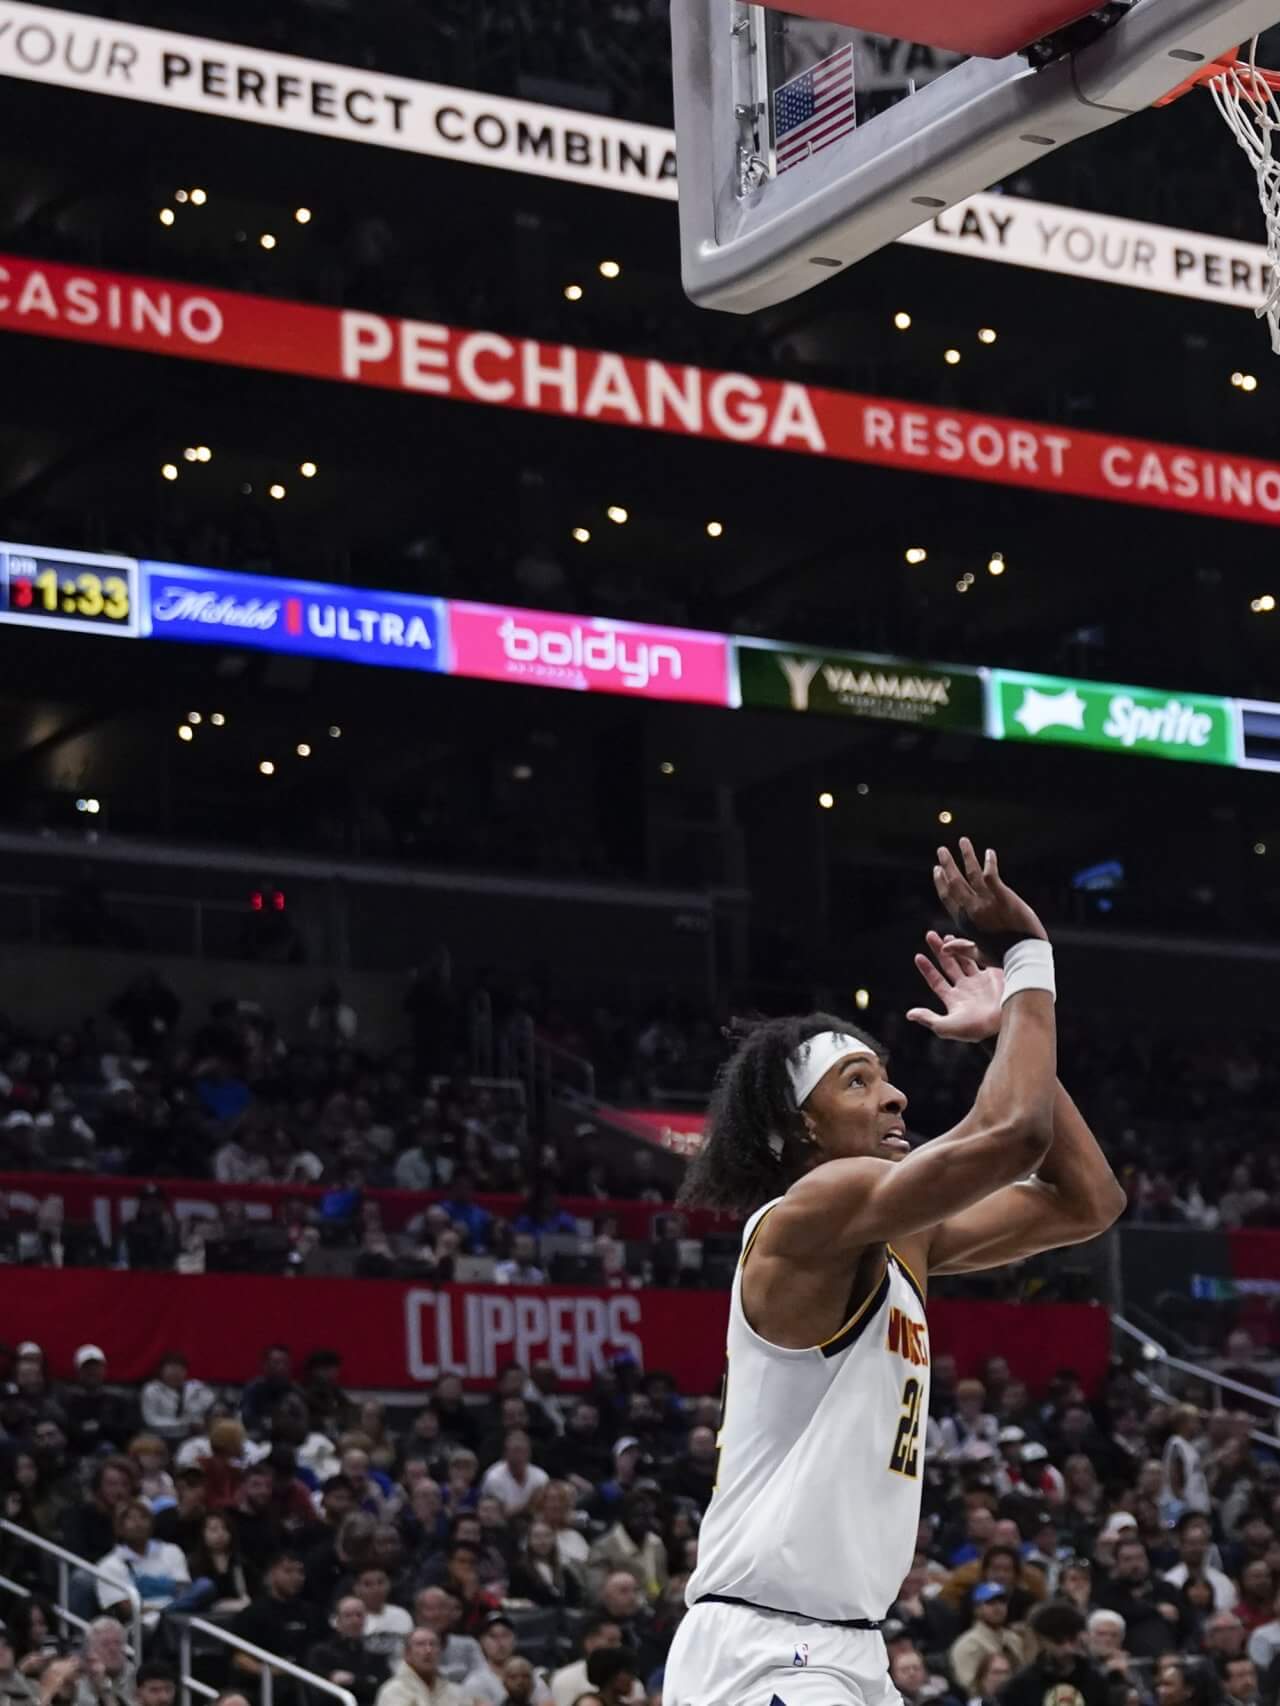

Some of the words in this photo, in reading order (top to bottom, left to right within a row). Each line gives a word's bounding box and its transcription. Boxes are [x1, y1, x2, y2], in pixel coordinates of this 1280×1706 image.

[162, 52, 412, 133] PERFECT
[933, 207, 1016, 245] LAY
[1036, 218, 1157, 275] YOUR
[339, 309, 826, 452] PECHANGA
[863, 407, 1070, 477] RESORT
[36, 568, 129, 619] 1:33
[153, 586, 280, 630] Michelob
[308, 603, 431, 650] ULTRA
[498, 617, 682, 688] boldyn
[1103, 694, 1212, 747] Sprite
[404, 1288, 643, 1381] CLIPPERS
